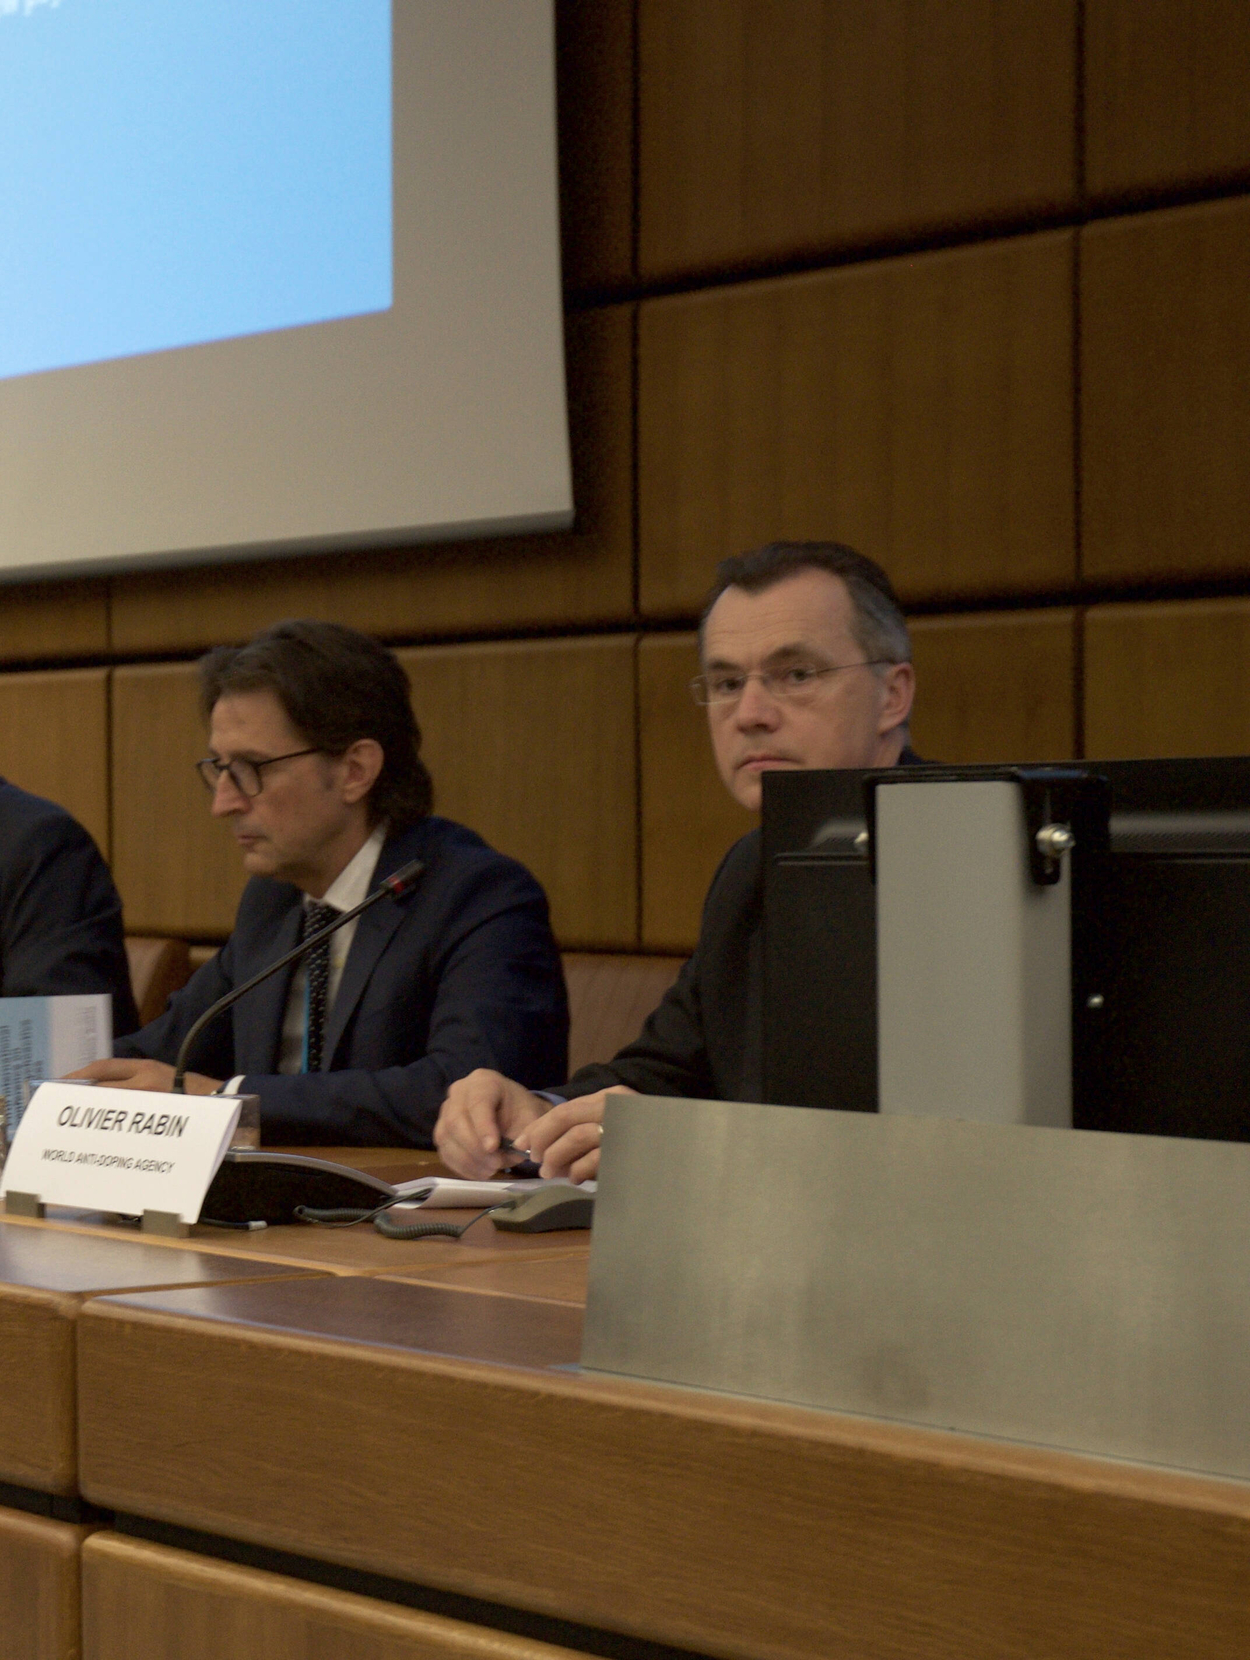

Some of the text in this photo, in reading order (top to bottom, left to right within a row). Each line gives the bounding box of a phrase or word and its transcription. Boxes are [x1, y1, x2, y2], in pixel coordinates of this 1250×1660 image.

[57, 1105, 191, 1138] OLIVIER RABIN
[41, 1149, 176, 1174] WORLD ANTI-DOPING AGENCY
